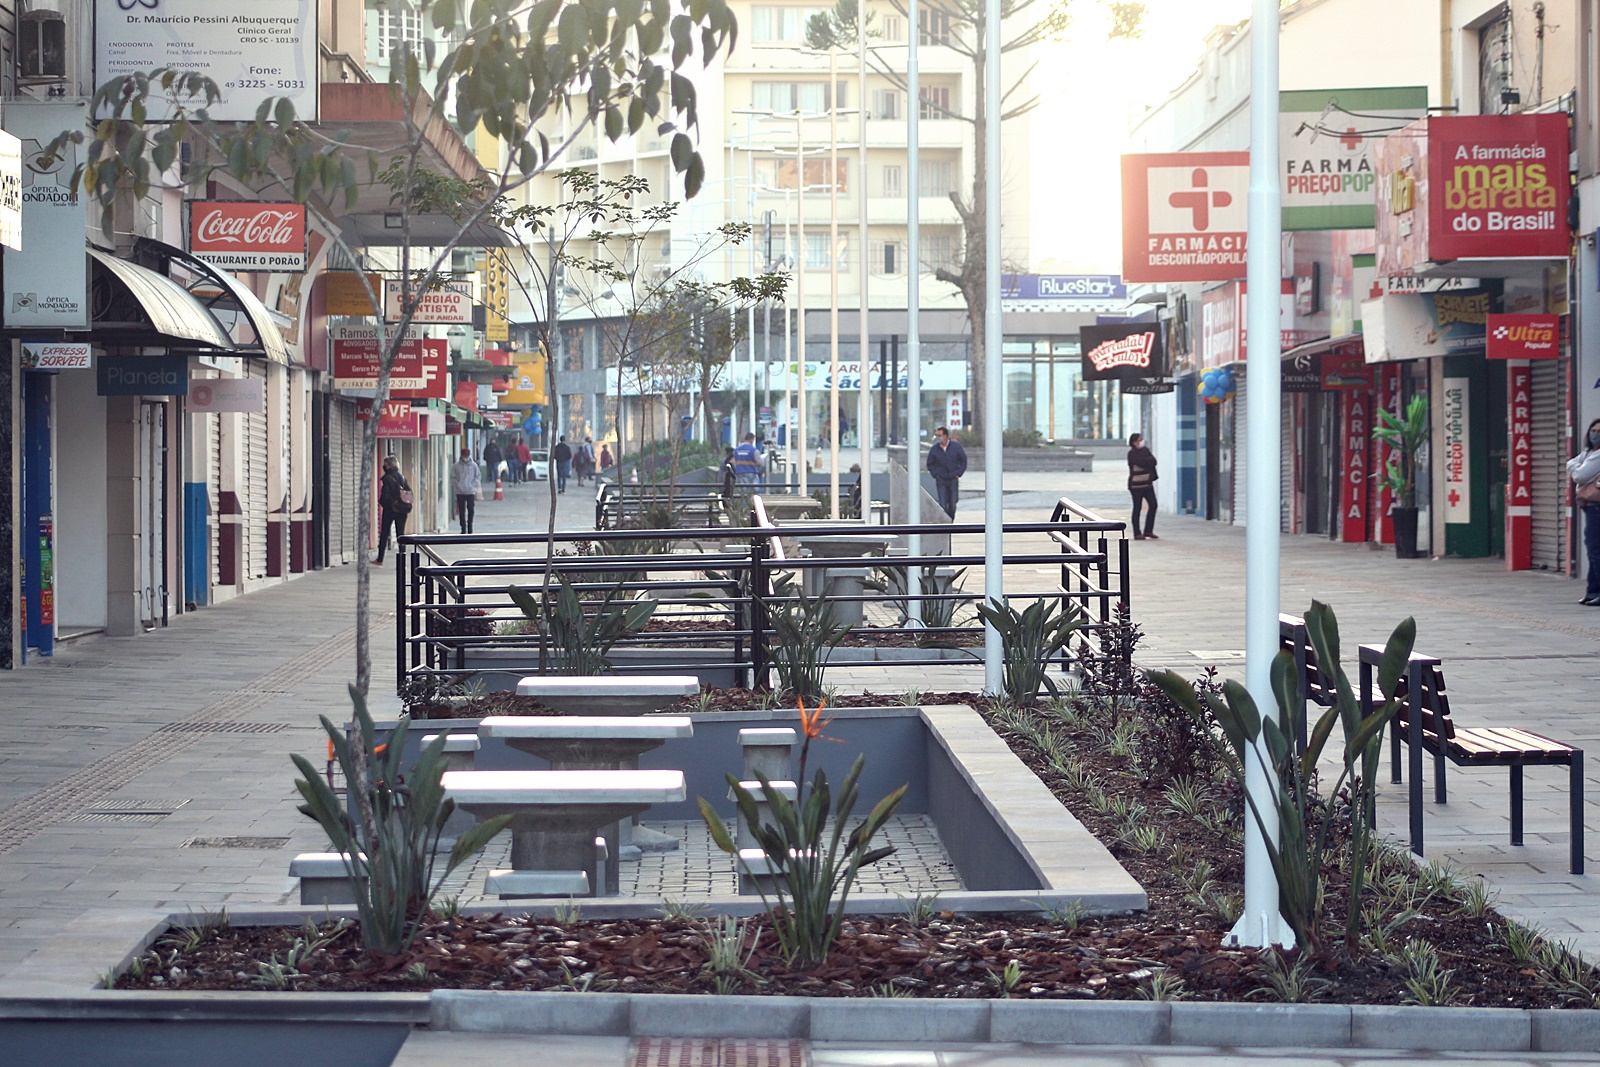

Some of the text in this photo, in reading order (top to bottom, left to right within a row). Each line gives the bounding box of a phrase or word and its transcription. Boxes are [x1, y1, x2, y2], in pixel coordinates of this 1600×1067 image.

[127, 15, 300, 26] Dr. Maurício Pessini Albuquerque
[237, 27, 292, 35] Clínico Geral
[249, 66, 281, 75] Fone:
[238, 79, 267, 89] 3225
[277, 79, 305, 89] 5031
[1455, 143, 1546, 160] A farmácia
[1454, 161, 1547, 190] mais
[32, 185, 58, 193] ÓPTICA
[1445, 180, 1556, 209] barata
[198, 209, 299, 244] Coca-Cola
[1452, 210, 1555, 231] do Brasil!
[260, 256, 266, 265] O
[269, 255, 300, 266] PORÃO
[390, 284, 400, 292] Dr.
[1041, 279, 1107, 294] BlueStar
[1508, 326, 1552, 342] Ultra
[42, 347, 88, 356] EXPRESSO
[1524, 341, 1552, 350] Popular
[40, 356, 88, 367] SORVETE
[107, 367, 177, 385] Planeta
[388, 404, 409, 417] VF
[1514, 375, 1530, 498] FARMÁCIA
